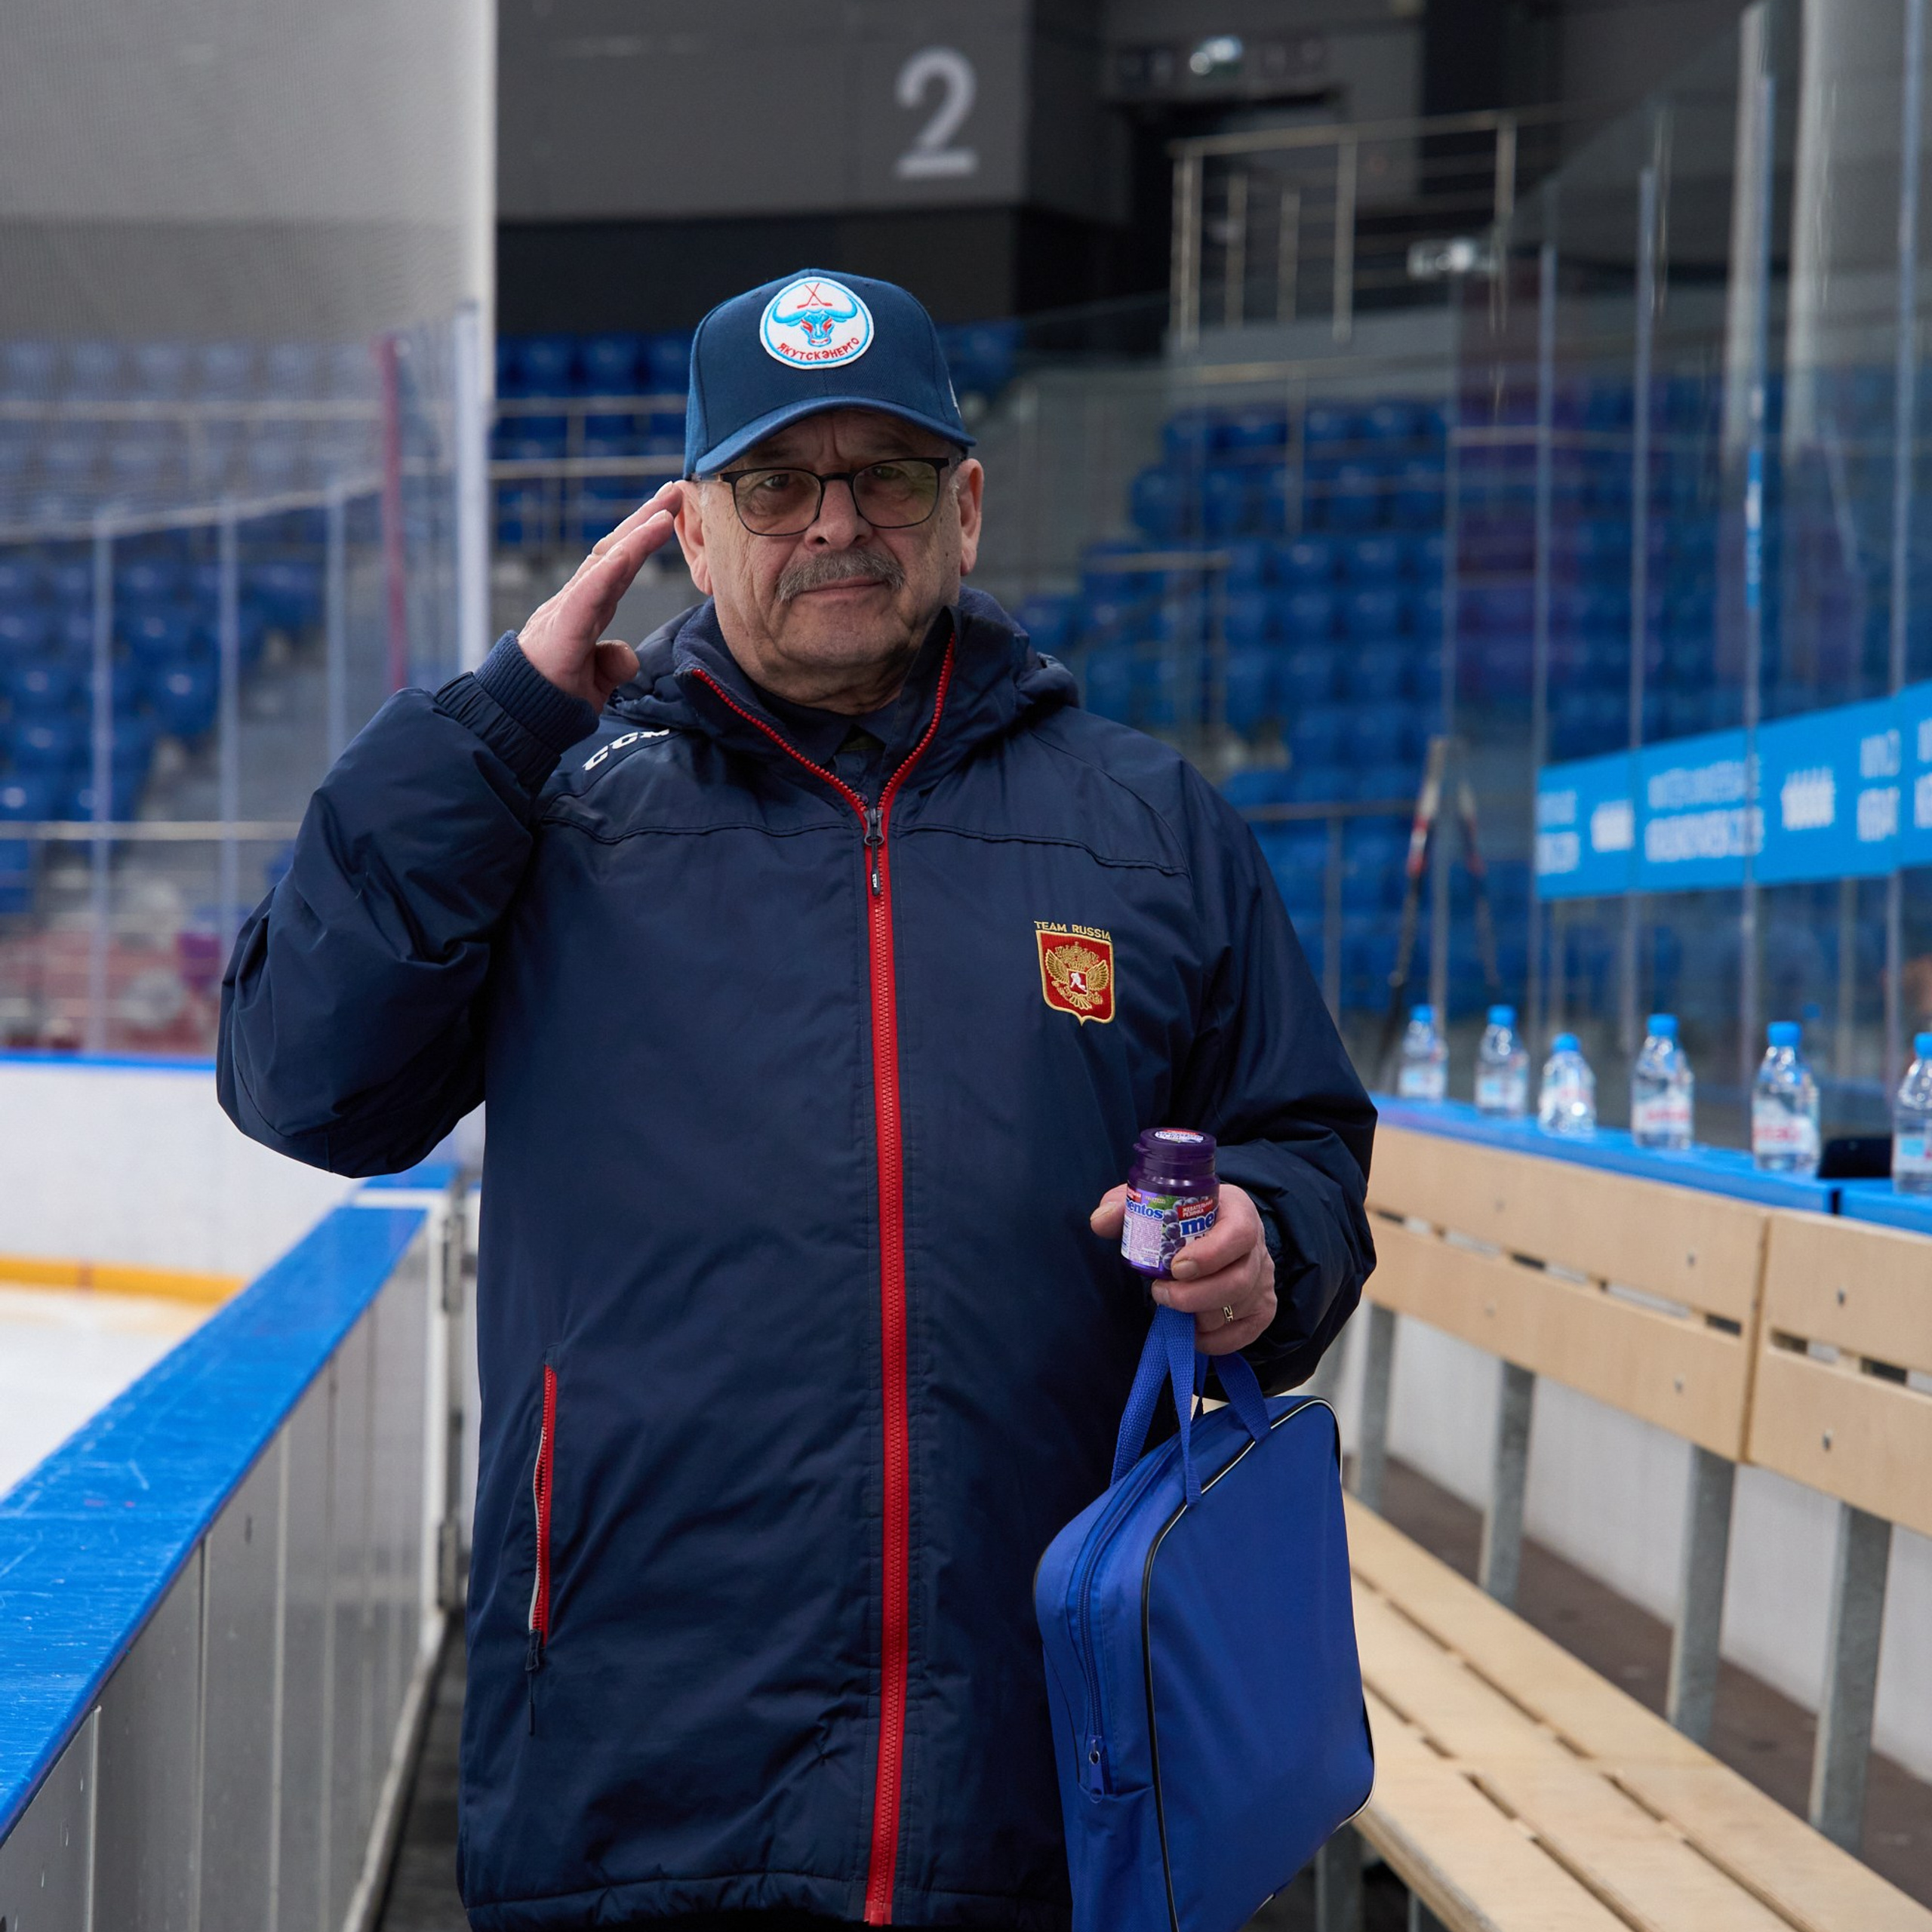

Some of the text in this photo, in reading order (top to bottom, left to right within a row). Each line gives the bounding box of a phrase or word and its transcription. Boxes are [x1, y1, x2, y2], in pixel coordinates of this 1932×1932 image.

[896, 46, 977, 180] 2
[777, 337, 860, 361] ЯКУТСКЭНЕРГО
[1034, 920, 1112, 942] TEAM RUSSIA
